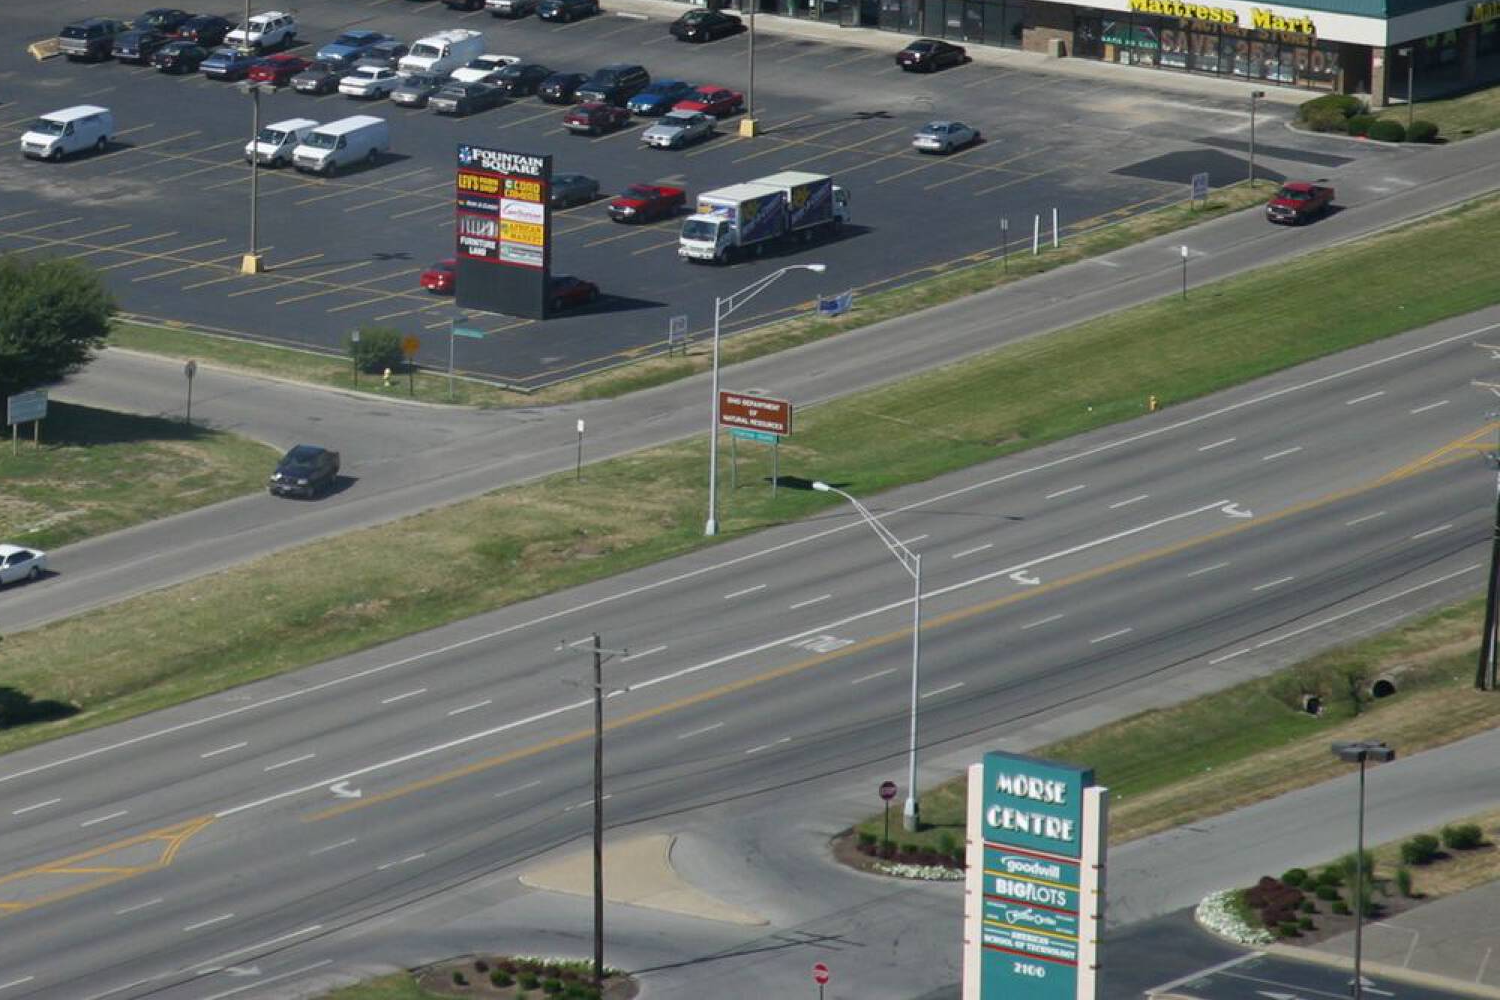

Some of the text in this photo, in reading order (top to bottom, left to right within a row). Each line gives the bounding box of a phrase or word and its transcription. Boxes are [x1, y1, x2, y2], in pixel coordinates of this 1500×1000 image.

[1250, 7, 1316, 34] Mart
[472, 148, 544, 168] FOUNTAIN
[481, 160, 539, 176] SQUARE
[996, 772, 1067, 804] MORSE
[986, 804, 1075, 842] CENTRE
[1007, 859, 1060, 879] goodwill
[1013, 961, 1046, 978] 2100
